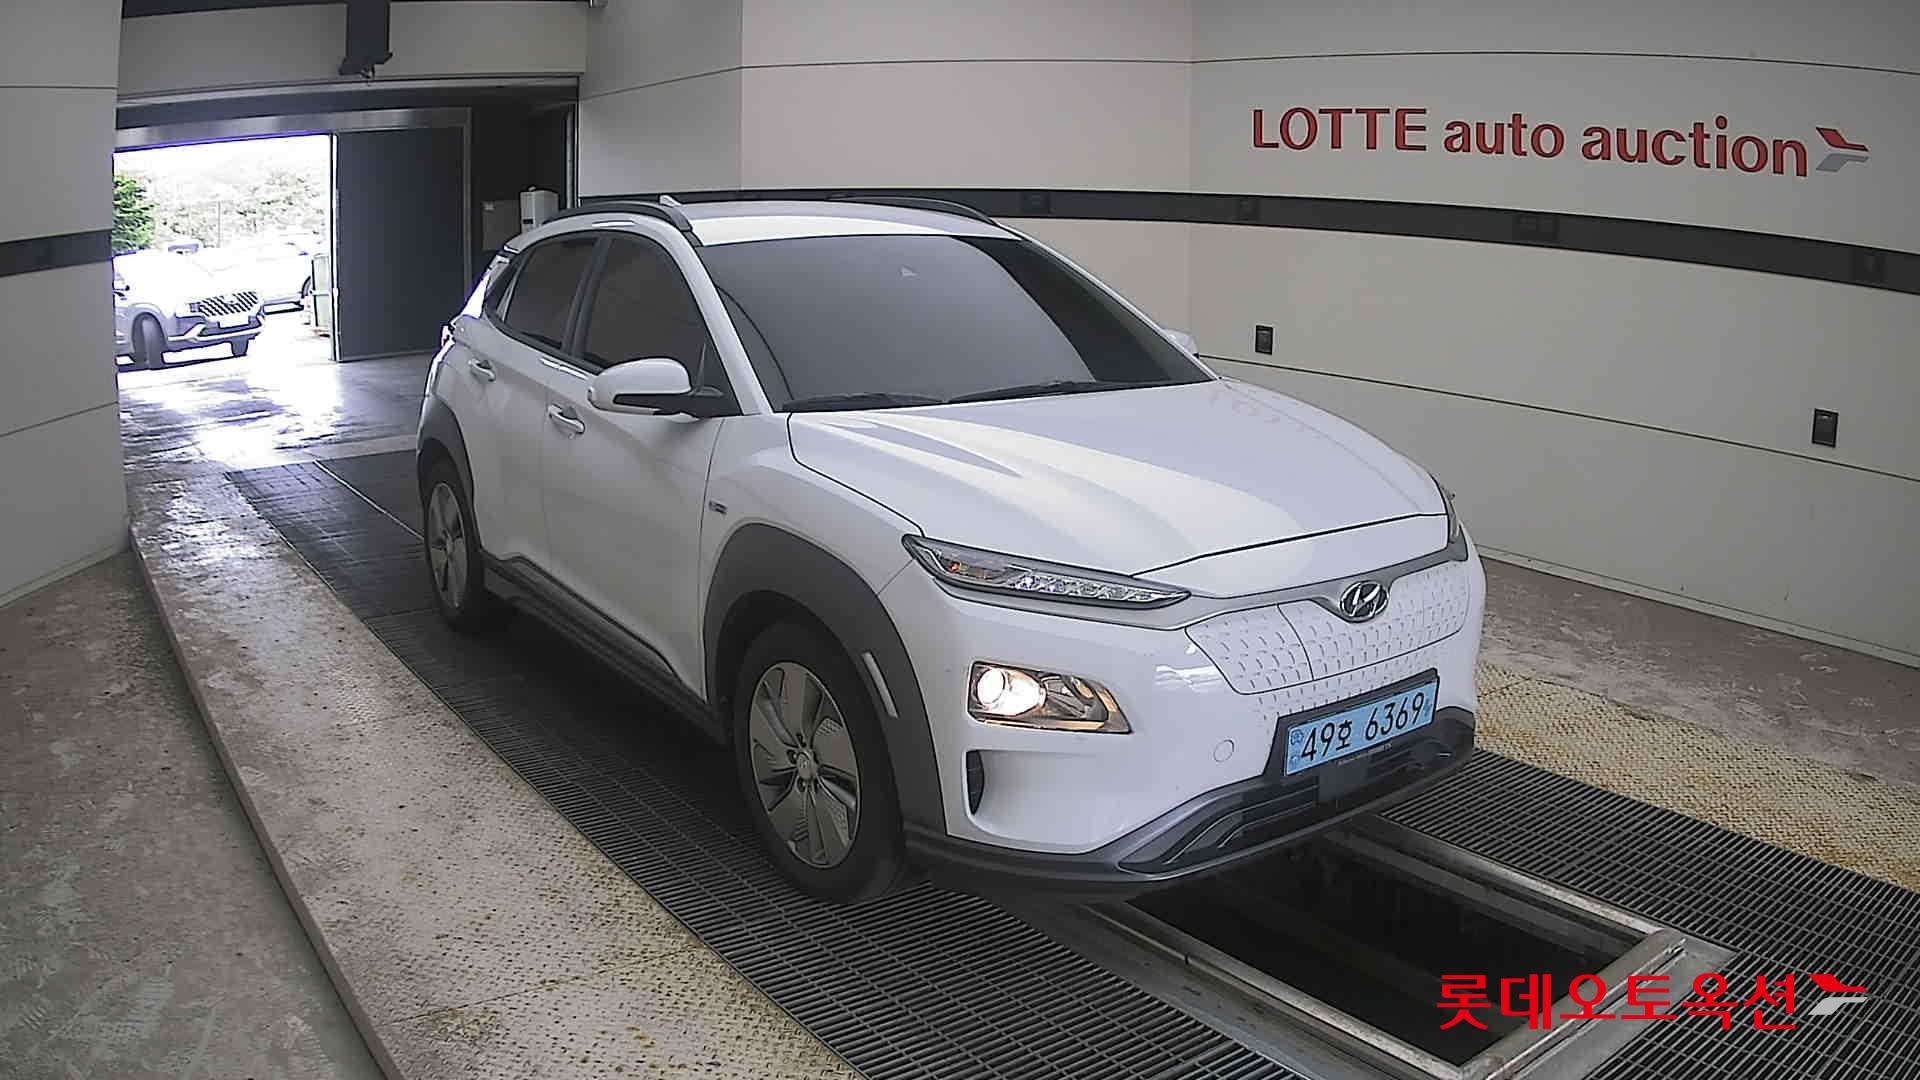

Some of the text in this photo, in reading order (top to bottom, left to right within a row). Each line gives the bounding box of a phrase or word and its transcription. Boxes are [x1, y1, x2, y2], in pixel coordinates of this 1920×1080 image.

[1252, 107, 1809, 177] LOTTE auto auction
[1301, 720, 1353, 761] 49호
[1365, 692, 1424, 740] 6369
